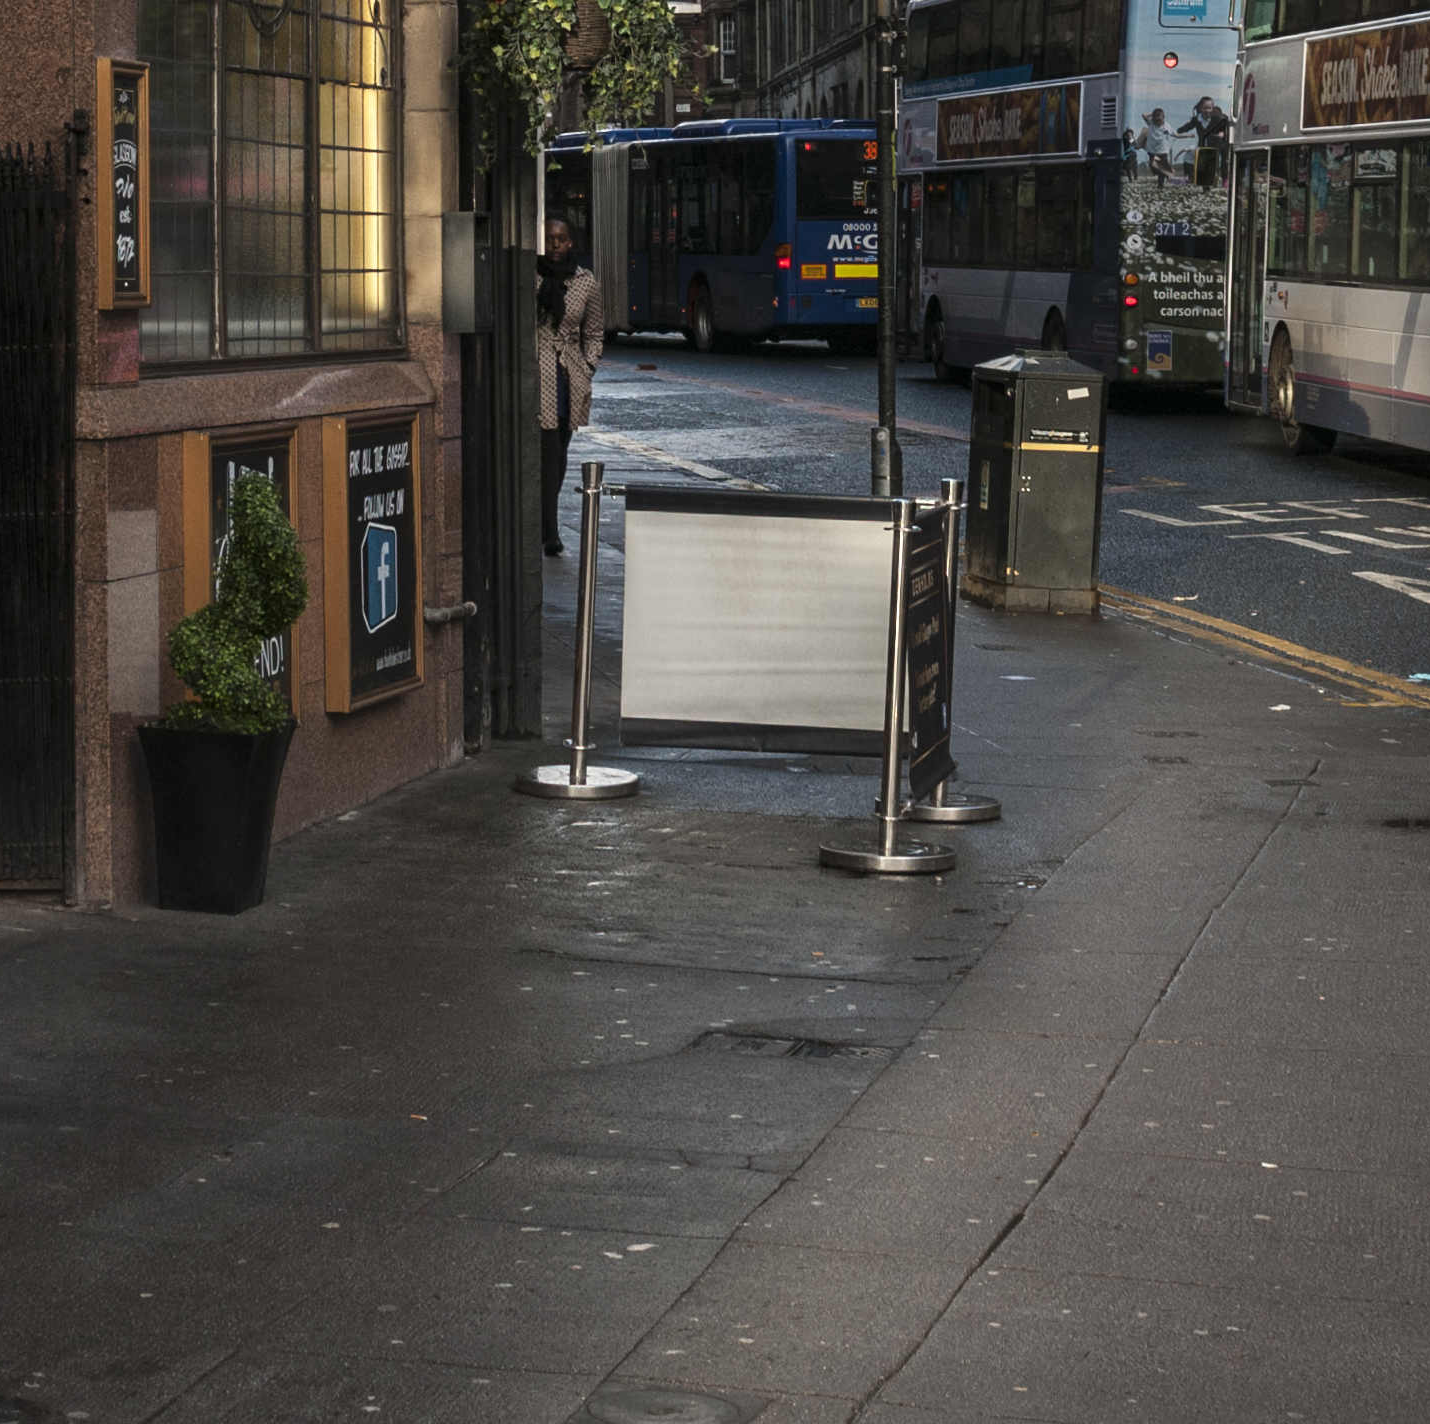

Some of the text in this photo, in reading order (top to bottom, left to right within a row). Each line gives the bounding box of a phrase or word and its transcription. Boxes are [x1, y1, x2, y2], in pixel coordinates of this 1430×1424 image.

[1360, 46, 1400, 102] Shake.
[1147, 273, 1158, 283] A
[1160, 271, 1191, 284] bheil
[1193, 271, 1214, 284] thu
[1153, 289, 1214, 301] toileachas
[1160, 307, 1199, 317] carson
